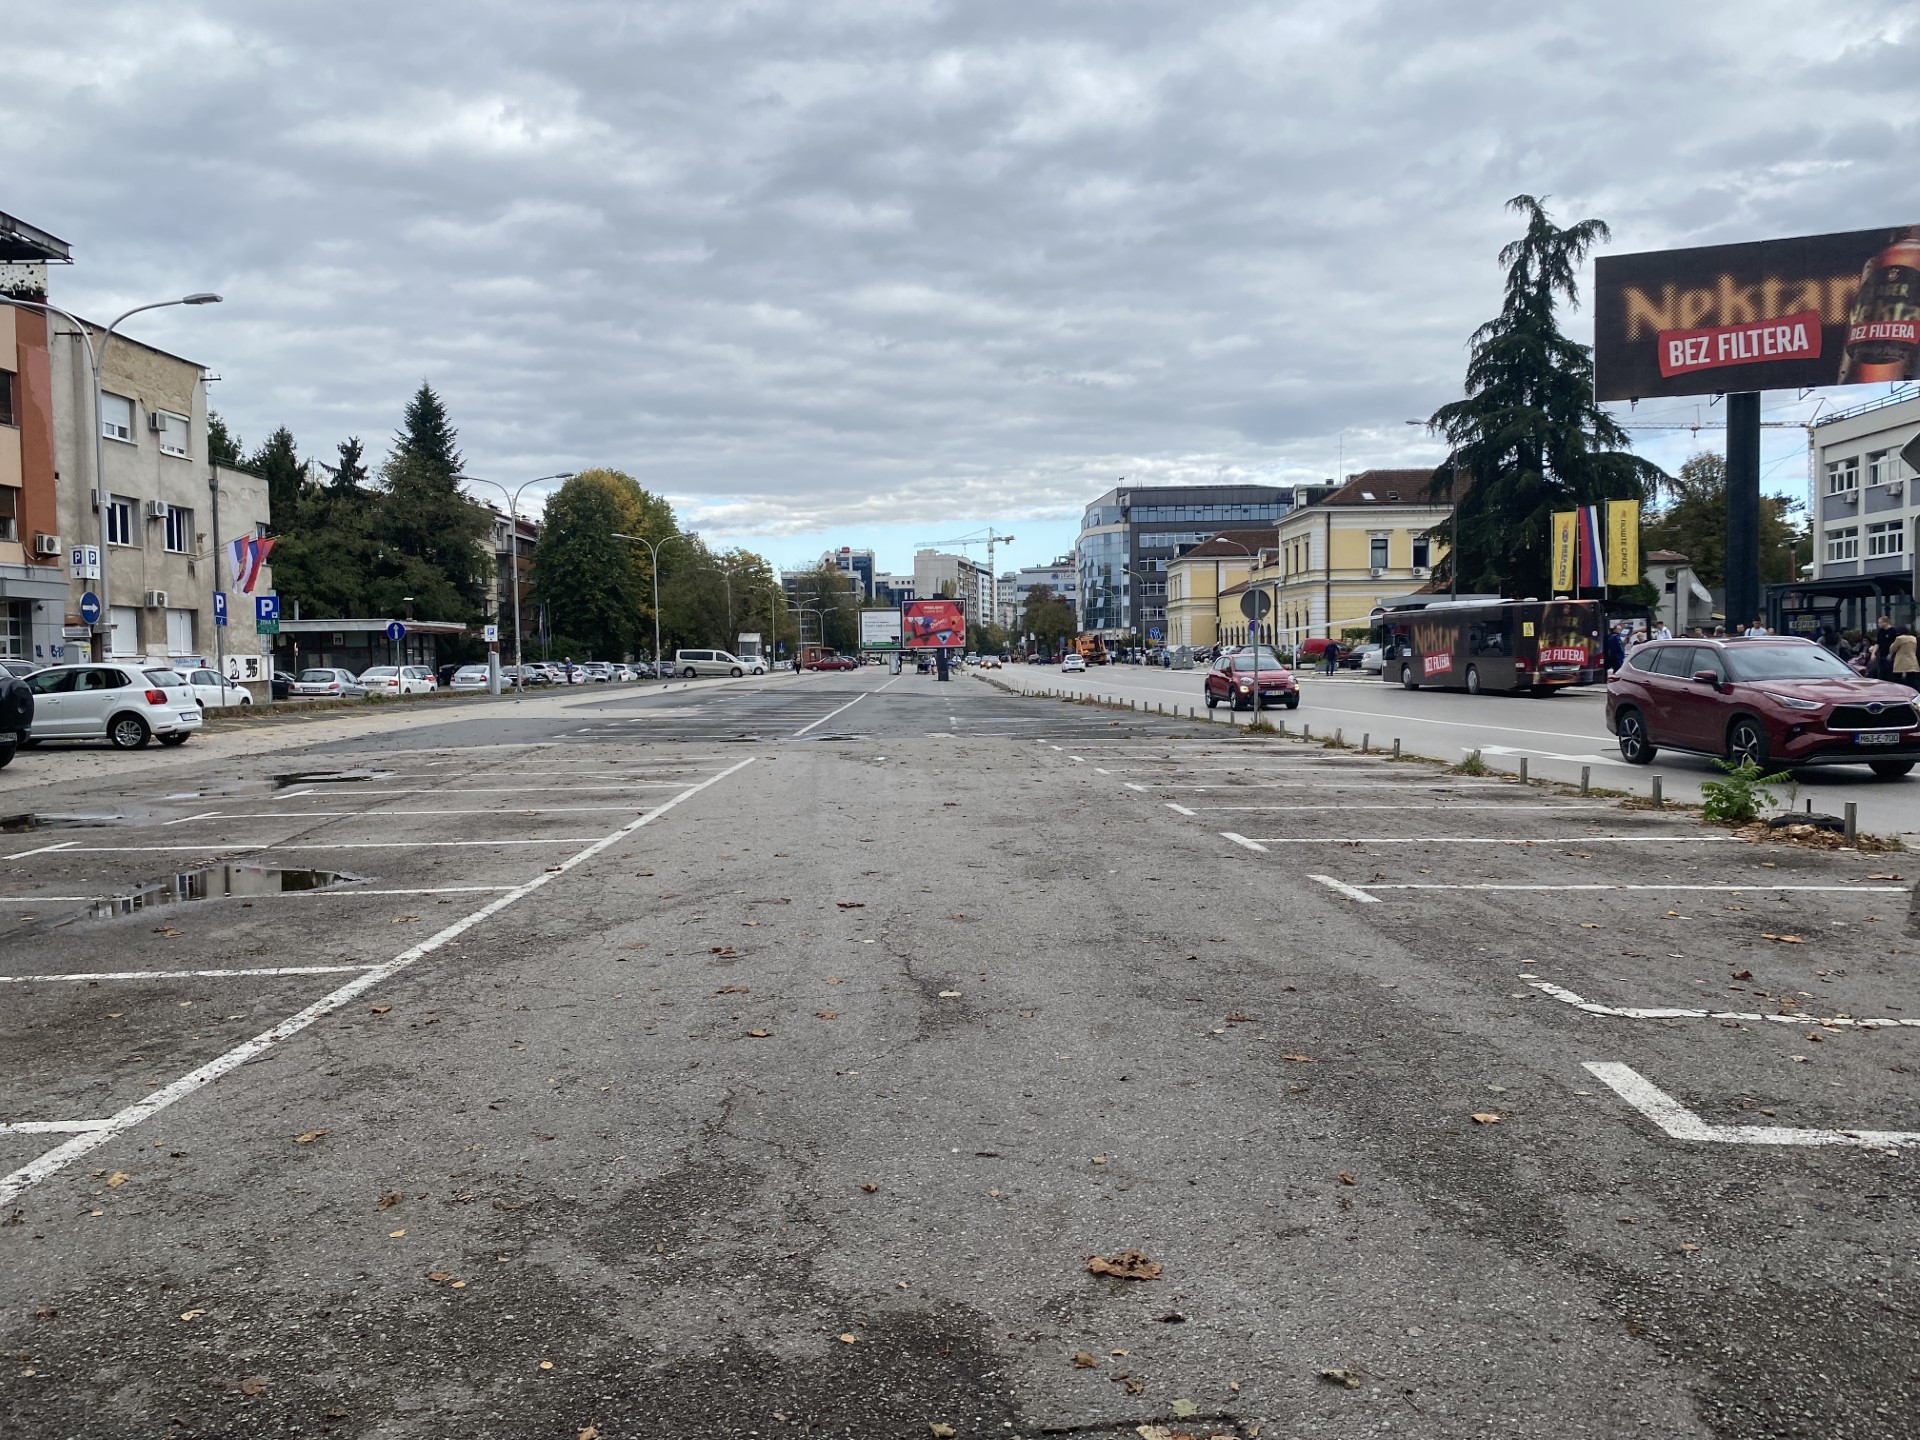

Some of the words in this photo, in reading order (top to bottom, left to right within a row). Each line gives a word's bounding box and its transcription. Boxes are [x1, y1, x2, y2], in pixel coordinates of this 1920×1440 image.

[1621, 273, 1860, 343] Nektar
[1850, 326, 1868, 341] BEZ
[1869, 324, 1915, 339] FILTERA
[1669, 336, 1711, 368] BEZ
[1719, 323, 1809, 361] FILTERA
[75, 552, 81, 564] P
[90, 552, 96, 564] P
[216, 594, 224, 613] P
[261, 599, 274, 617] P
[1413, 623, 1459, 656] Nektar
[1424, 656, 1434, 672] BEZ
[1433, 653, 1450, 671] FILTERA
[1540, 649, 1552, 662] BEZ
[1553, 648, 1585, 662] FILTERA
